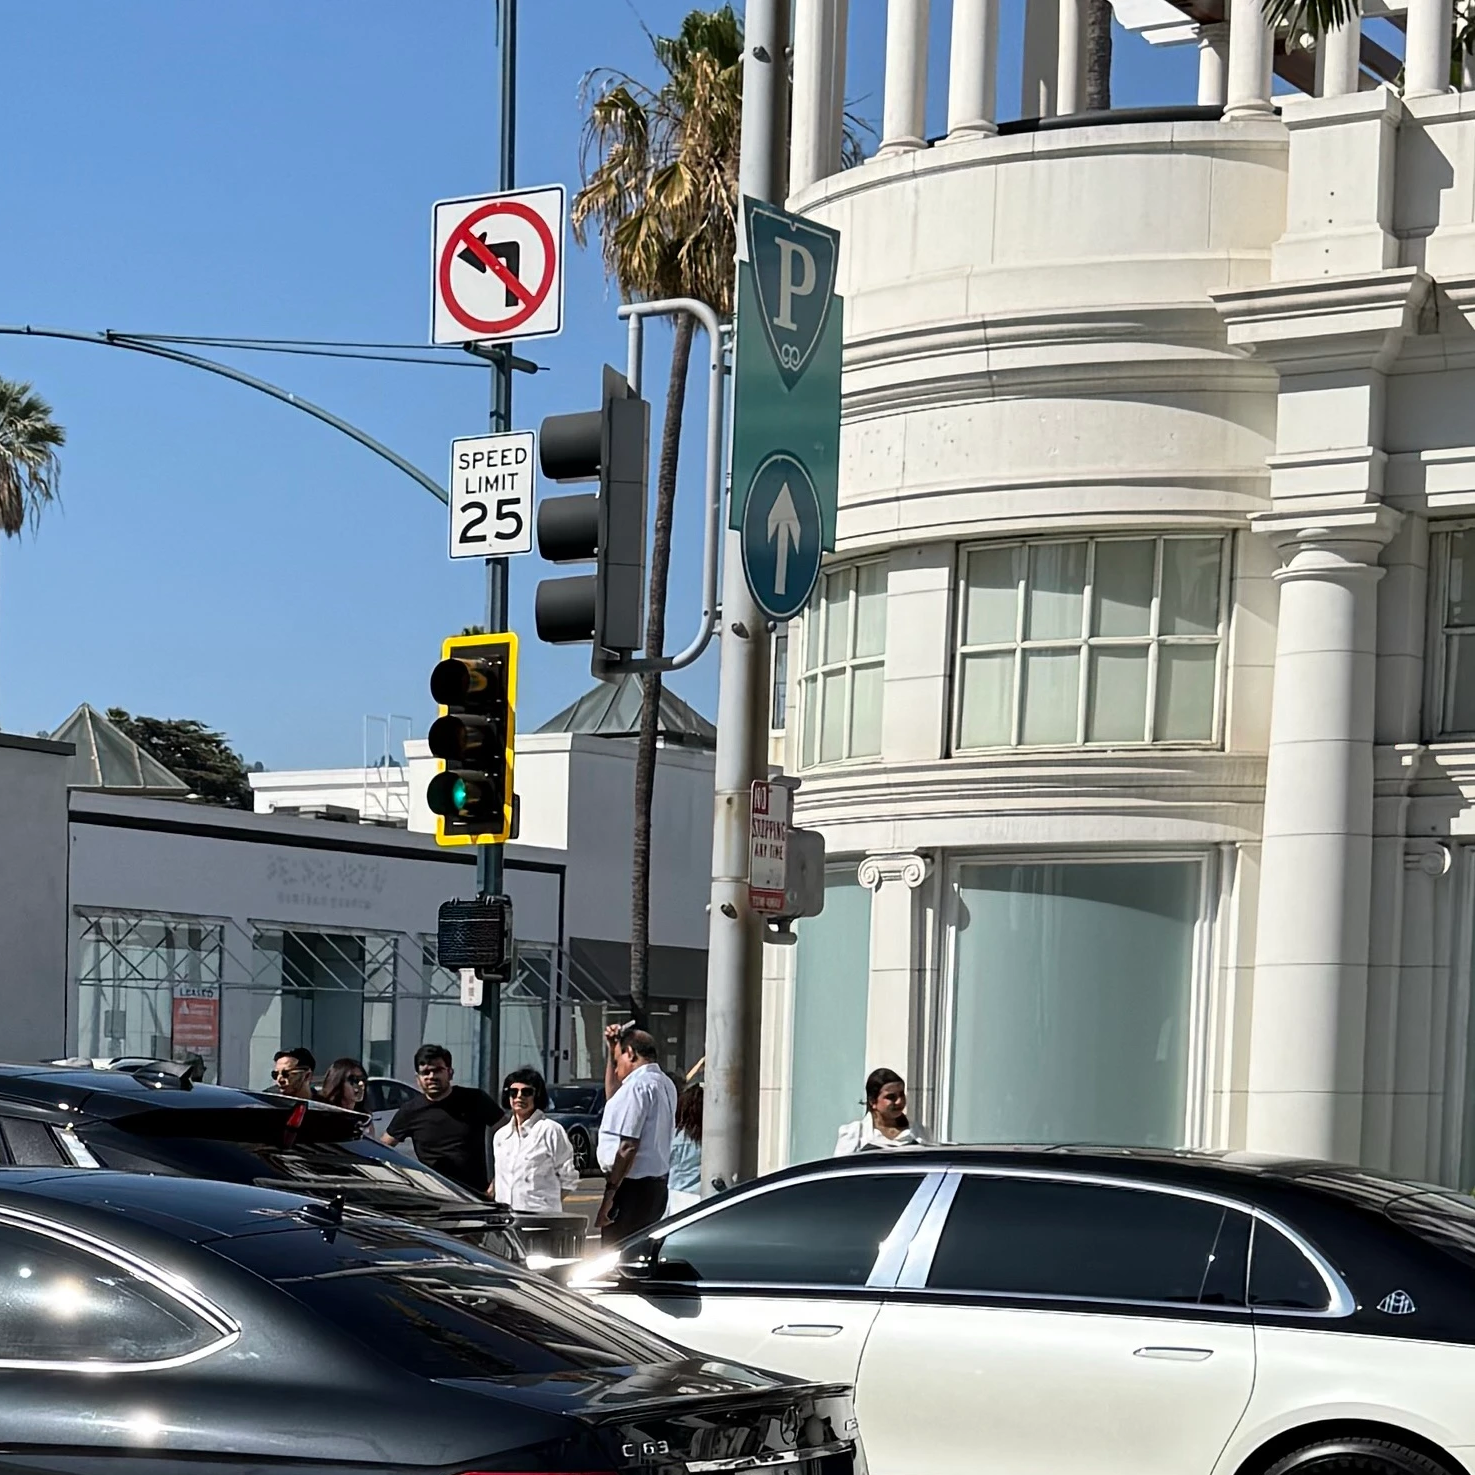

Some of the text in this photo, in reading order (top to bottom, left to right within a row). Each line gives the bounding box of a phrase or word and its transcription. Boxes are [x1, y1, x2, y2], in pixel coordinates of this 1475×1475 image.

[773, 236, 816, 331] P
[459, 448, 527, 470] SPEED
[466, 473, 518, 494] LIMIT
[459, 498, 523, 544] 25
[754, 786, 767, 810] NO
[752, 818, 785, 841] STOPPING
[754, 843, 783, 860] ANY TIME
[622, 1440, 669, 1457] C 63
